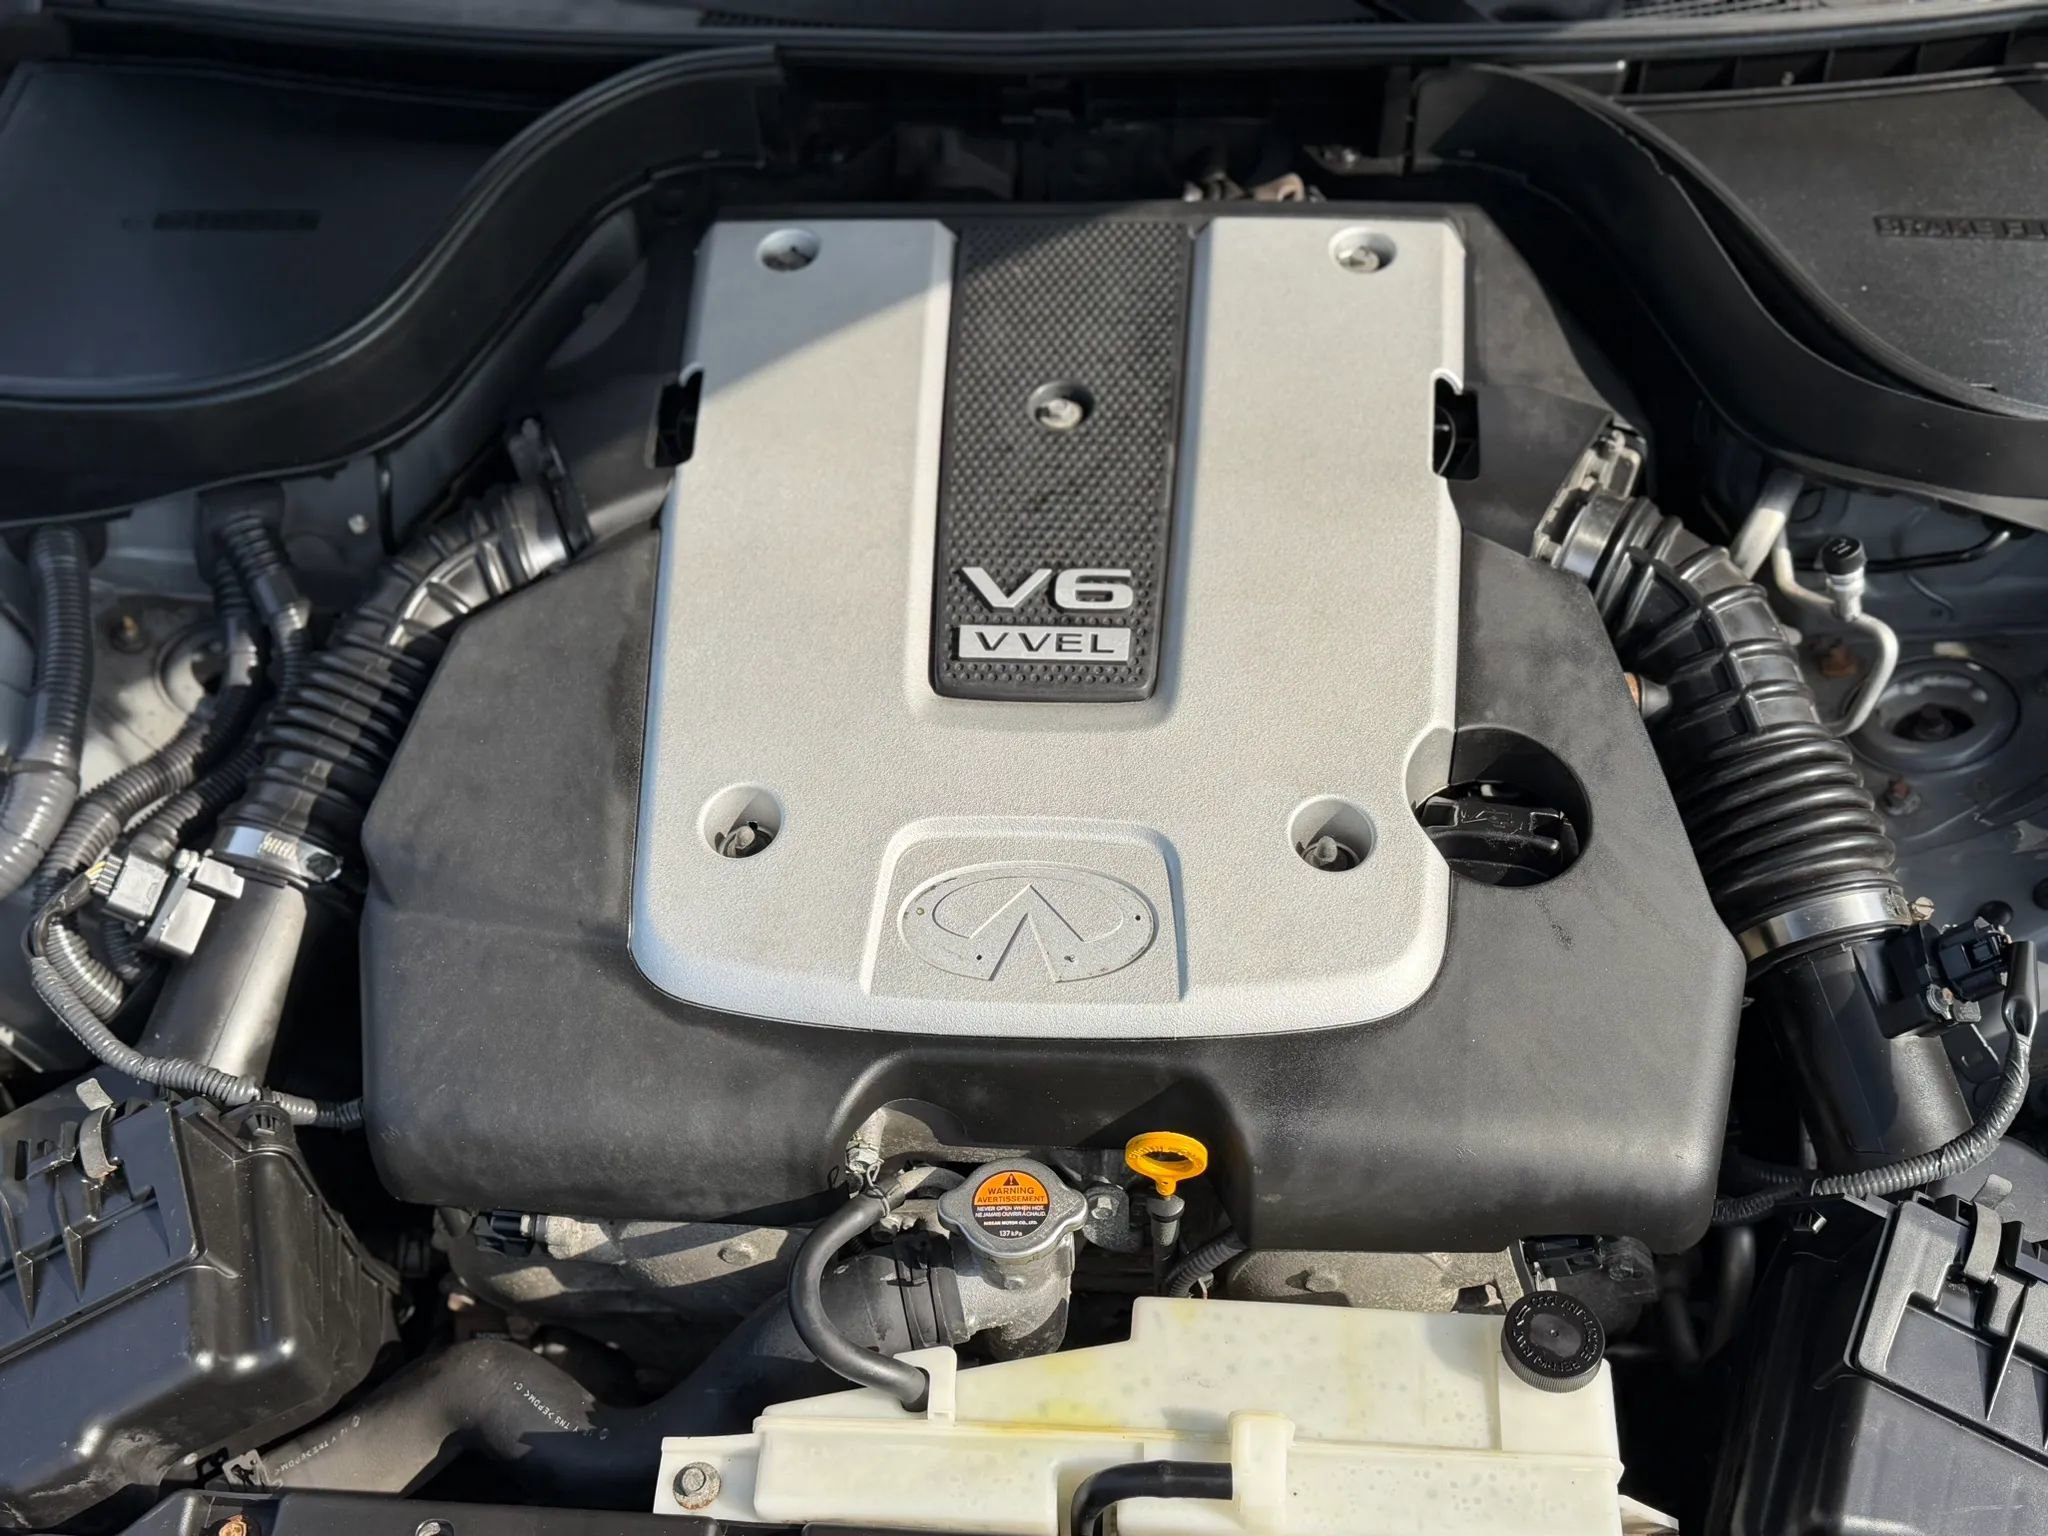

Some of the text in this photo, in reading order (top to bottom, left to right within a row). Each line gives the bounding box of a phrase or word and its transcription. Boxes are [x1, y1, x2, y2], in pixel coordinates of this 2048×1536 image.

[1873, 216, 1996, 238] BRAKE
[959, 566, 1135, 610] V6
[974, 631, 1115, 654] VVEL
[988, 1187, 1035, 1195] WARNING
